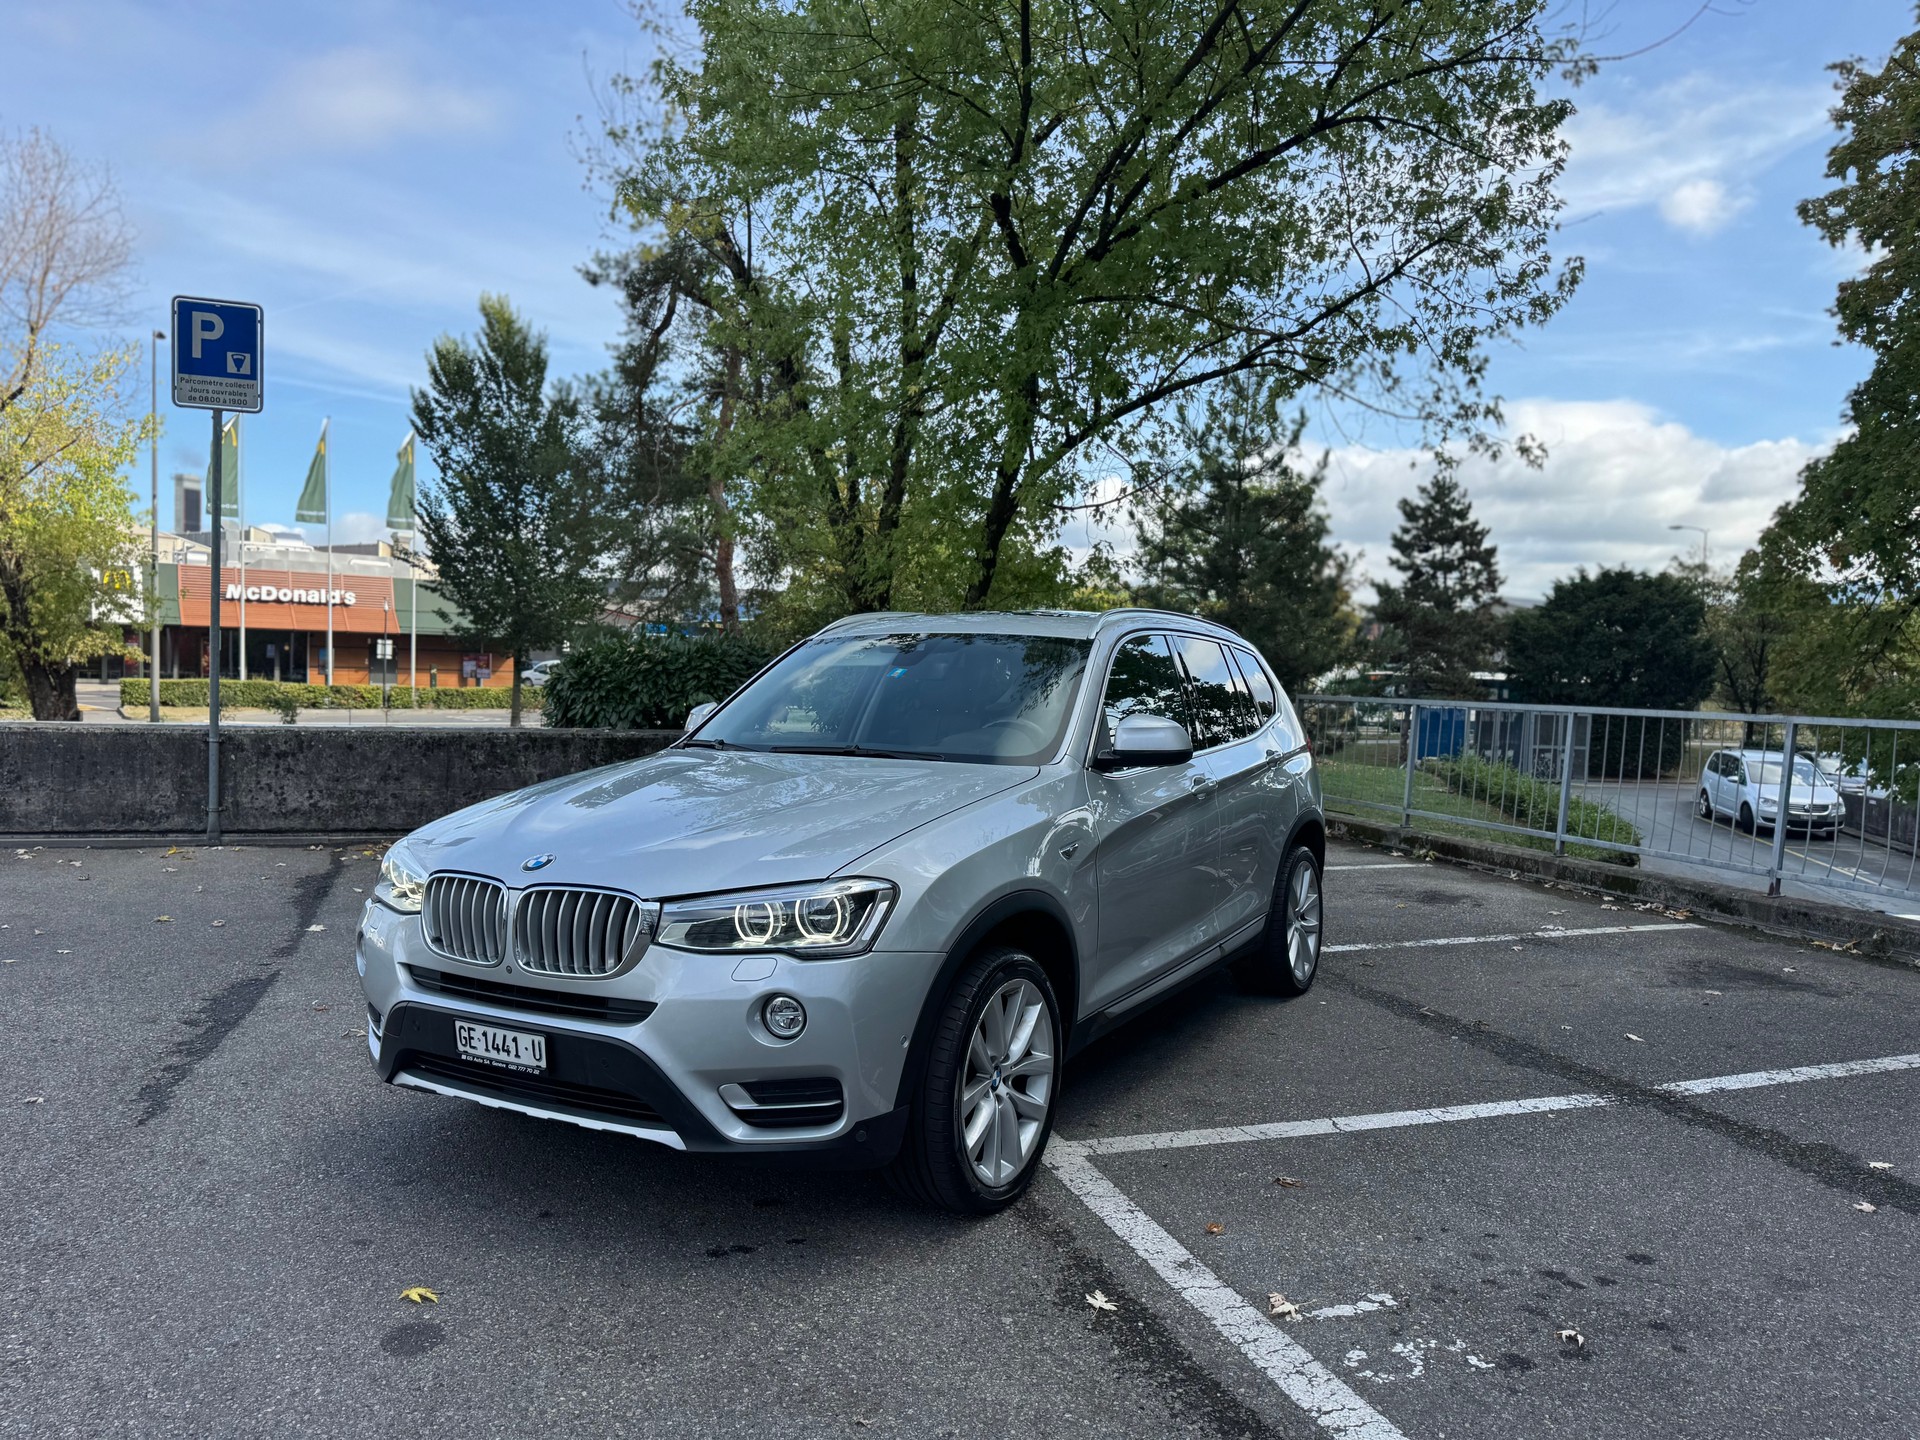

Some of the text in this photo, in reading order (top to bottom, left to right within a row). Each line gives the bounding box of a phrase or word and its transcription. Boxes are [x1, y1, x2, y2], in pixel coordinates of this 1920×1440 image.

[192, 310, 224, 358] P
[180, 376, 255, 390] Parcomètre collectif
[188, 386, 248, 397] Jours ouvrables
[226, 584, 357, 606] McDonald's
